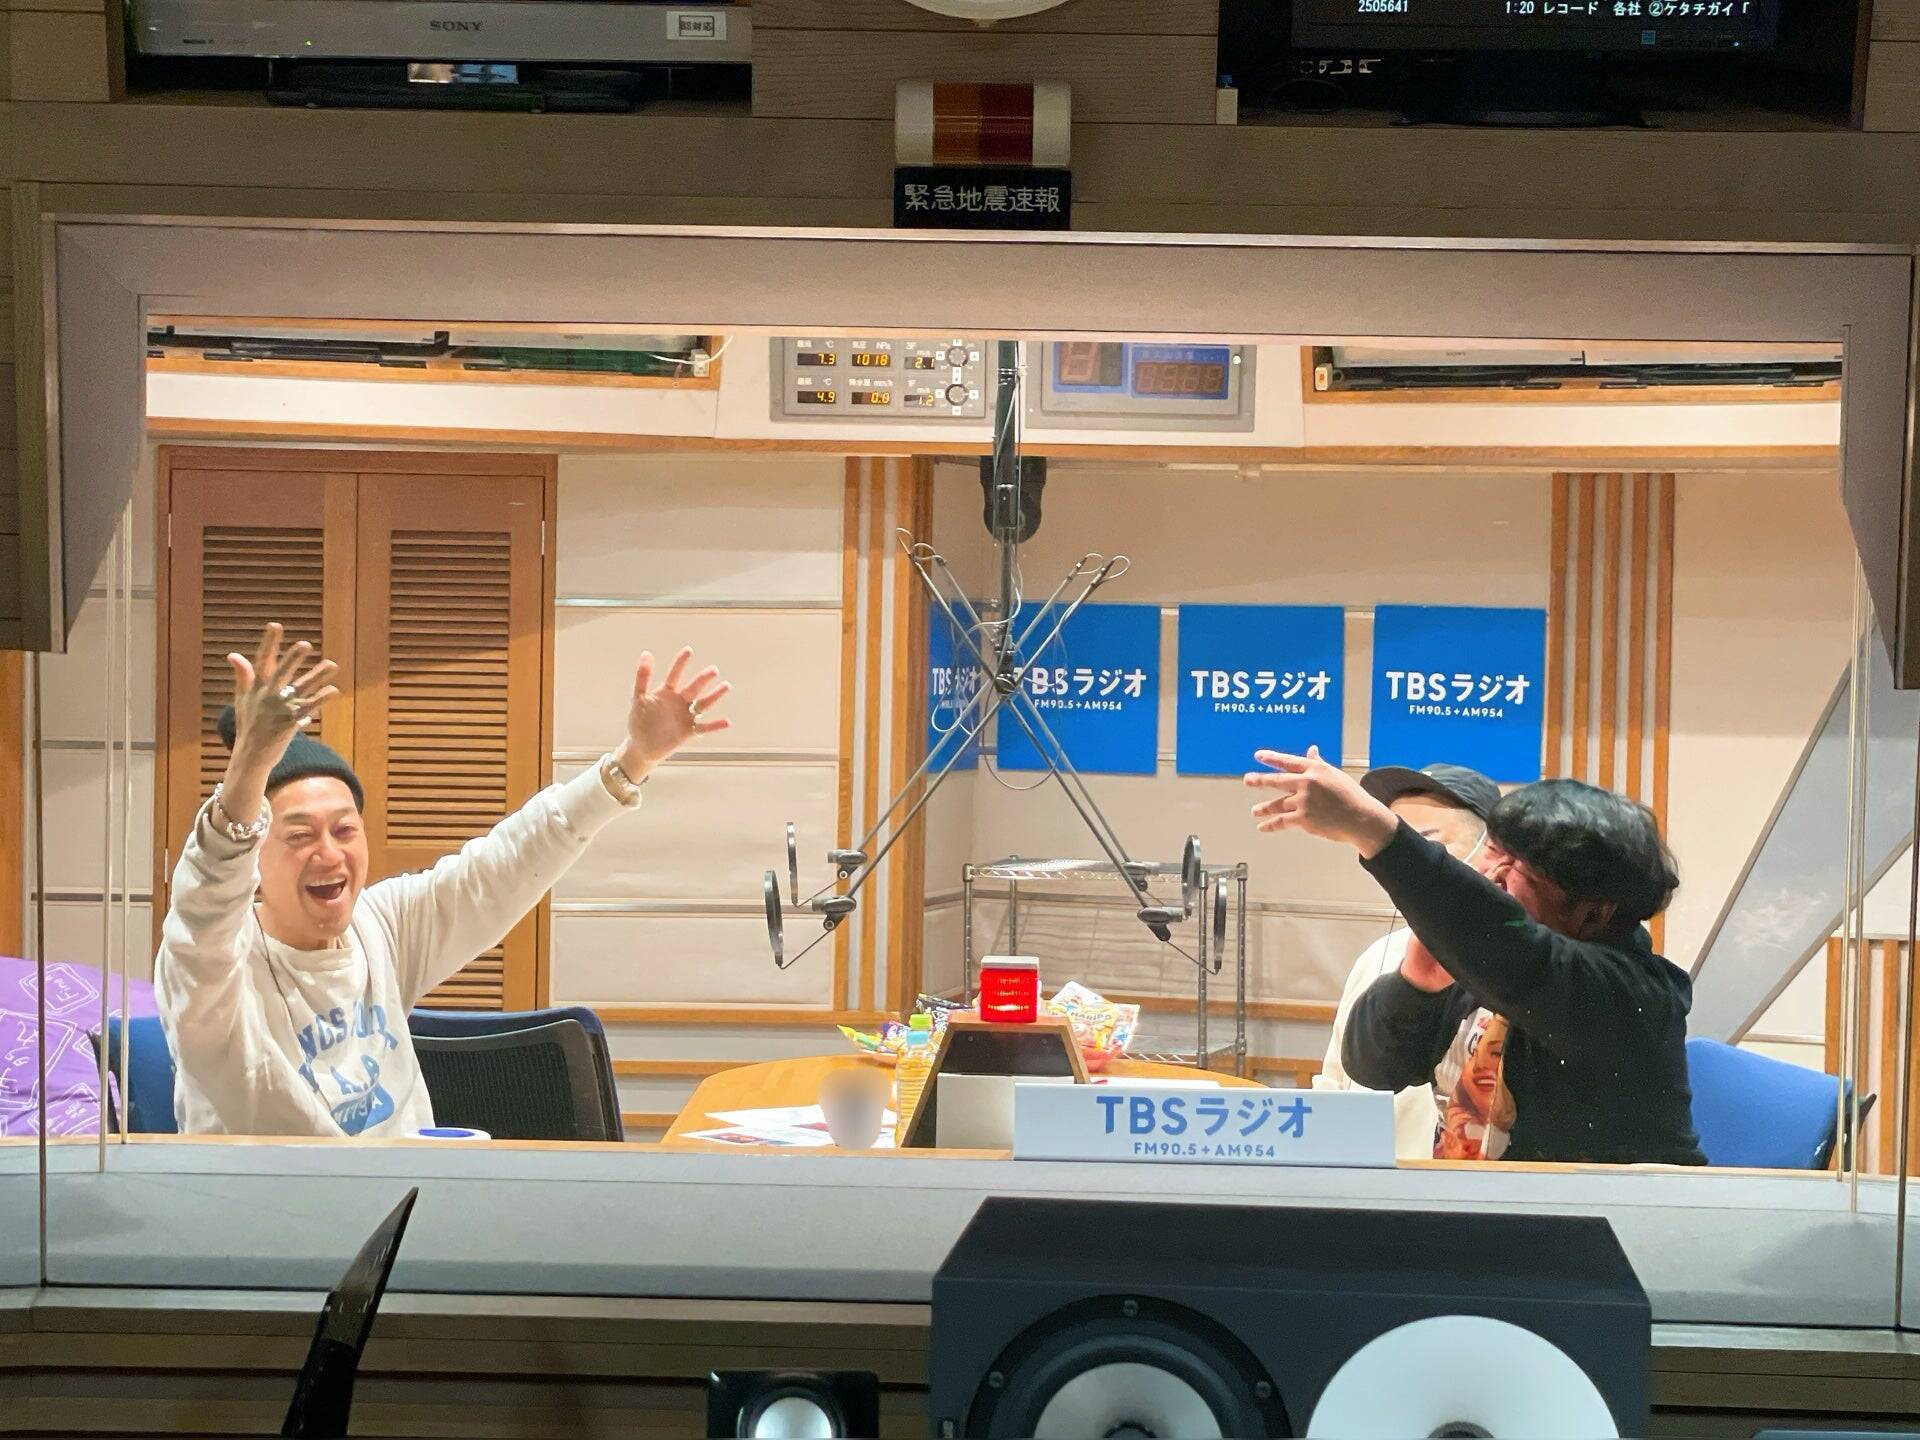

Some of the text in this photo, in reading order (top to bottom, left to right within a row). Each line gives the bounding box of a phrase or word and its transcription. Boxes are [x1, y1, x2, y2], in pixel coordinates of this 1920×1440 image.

[1358, 0, 1408, 12] 2505641
[1506, 1, 1534, 14] 1:20
[1543, 1, 1599, 14] レコード
[1613, 1, 1642, 16] 各社
[430, 20, 482, 32] SONY
[904, 183, 1061, 213] 緊急地震速報
[817, 391, 835, 403] 4.9
[1190, 671, 1331, 701] TBSラジオ
[1386, 671, 1530, 705] TBSラジオ
[1096, 1095, 1313, 1138] TBSラジオ
[1133, 1142, 1275, 1158] FM90.5+AM954
